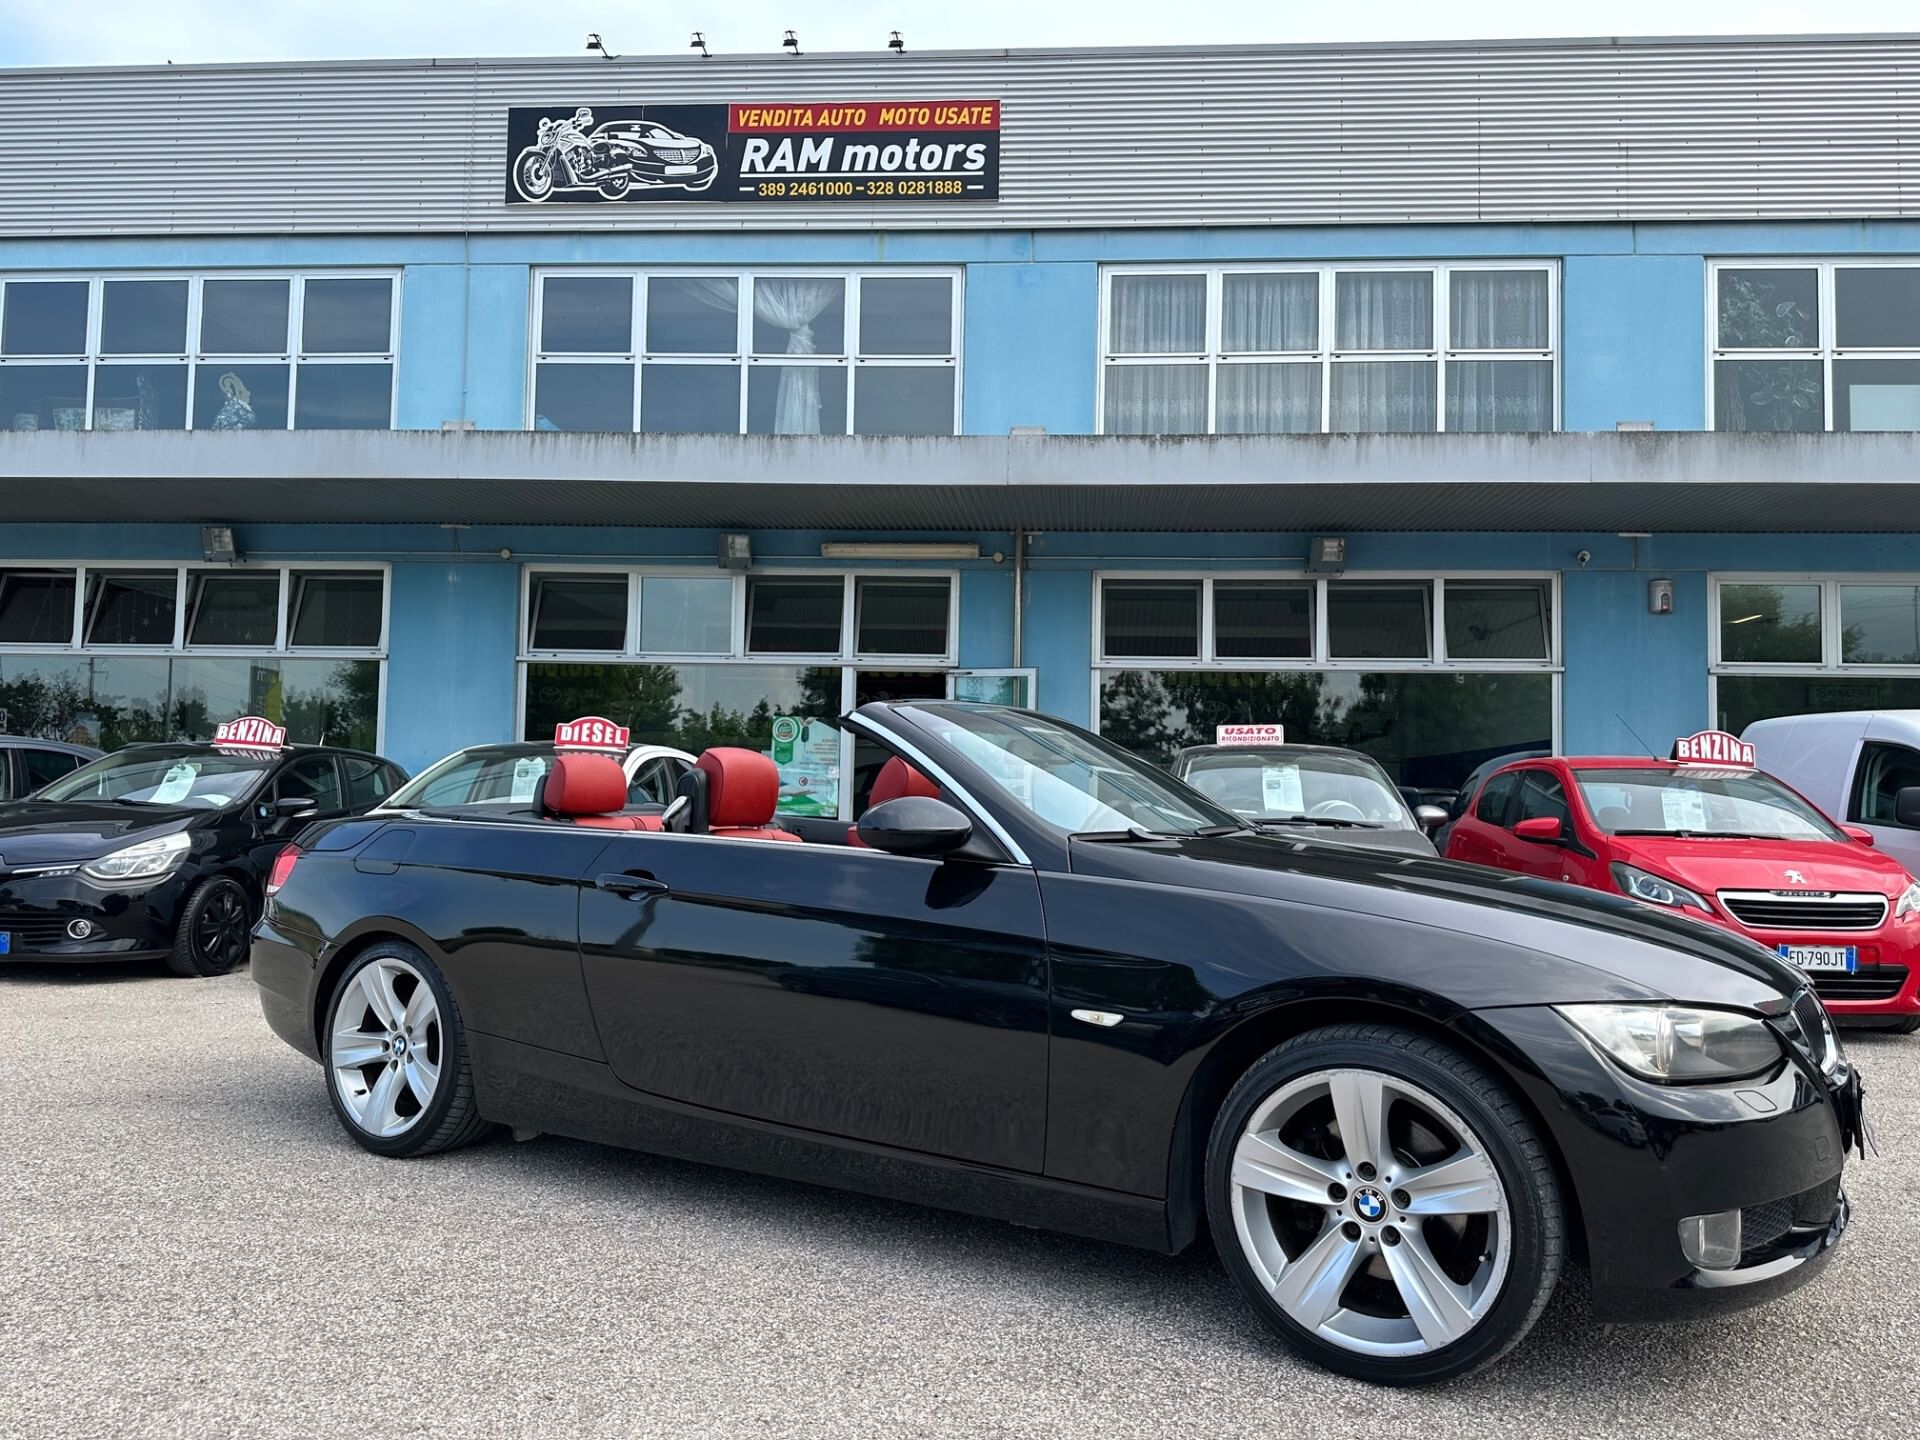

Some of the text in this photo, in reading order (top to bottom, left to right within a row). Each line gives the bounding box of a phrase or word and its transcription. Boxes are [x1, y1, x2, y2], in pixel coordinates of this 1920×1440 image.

[738, 107, 993, 127] VENDITA AUTO MOTO USATE
[740, 138, 987, 172] RAM motors
[758, 183, 786, 196] 389
[789, 182, 853, 196] 2461000
[867, 181, 894, 195] 328
[898, 181, 962, 194] 0281888
[216, 719, 282, 744] BENZINA
[560, 722, 625, 744] DIESEL
[1224, 727, 1276, 735] USATO
[1678, 734, 1753, 763] BENZINA
